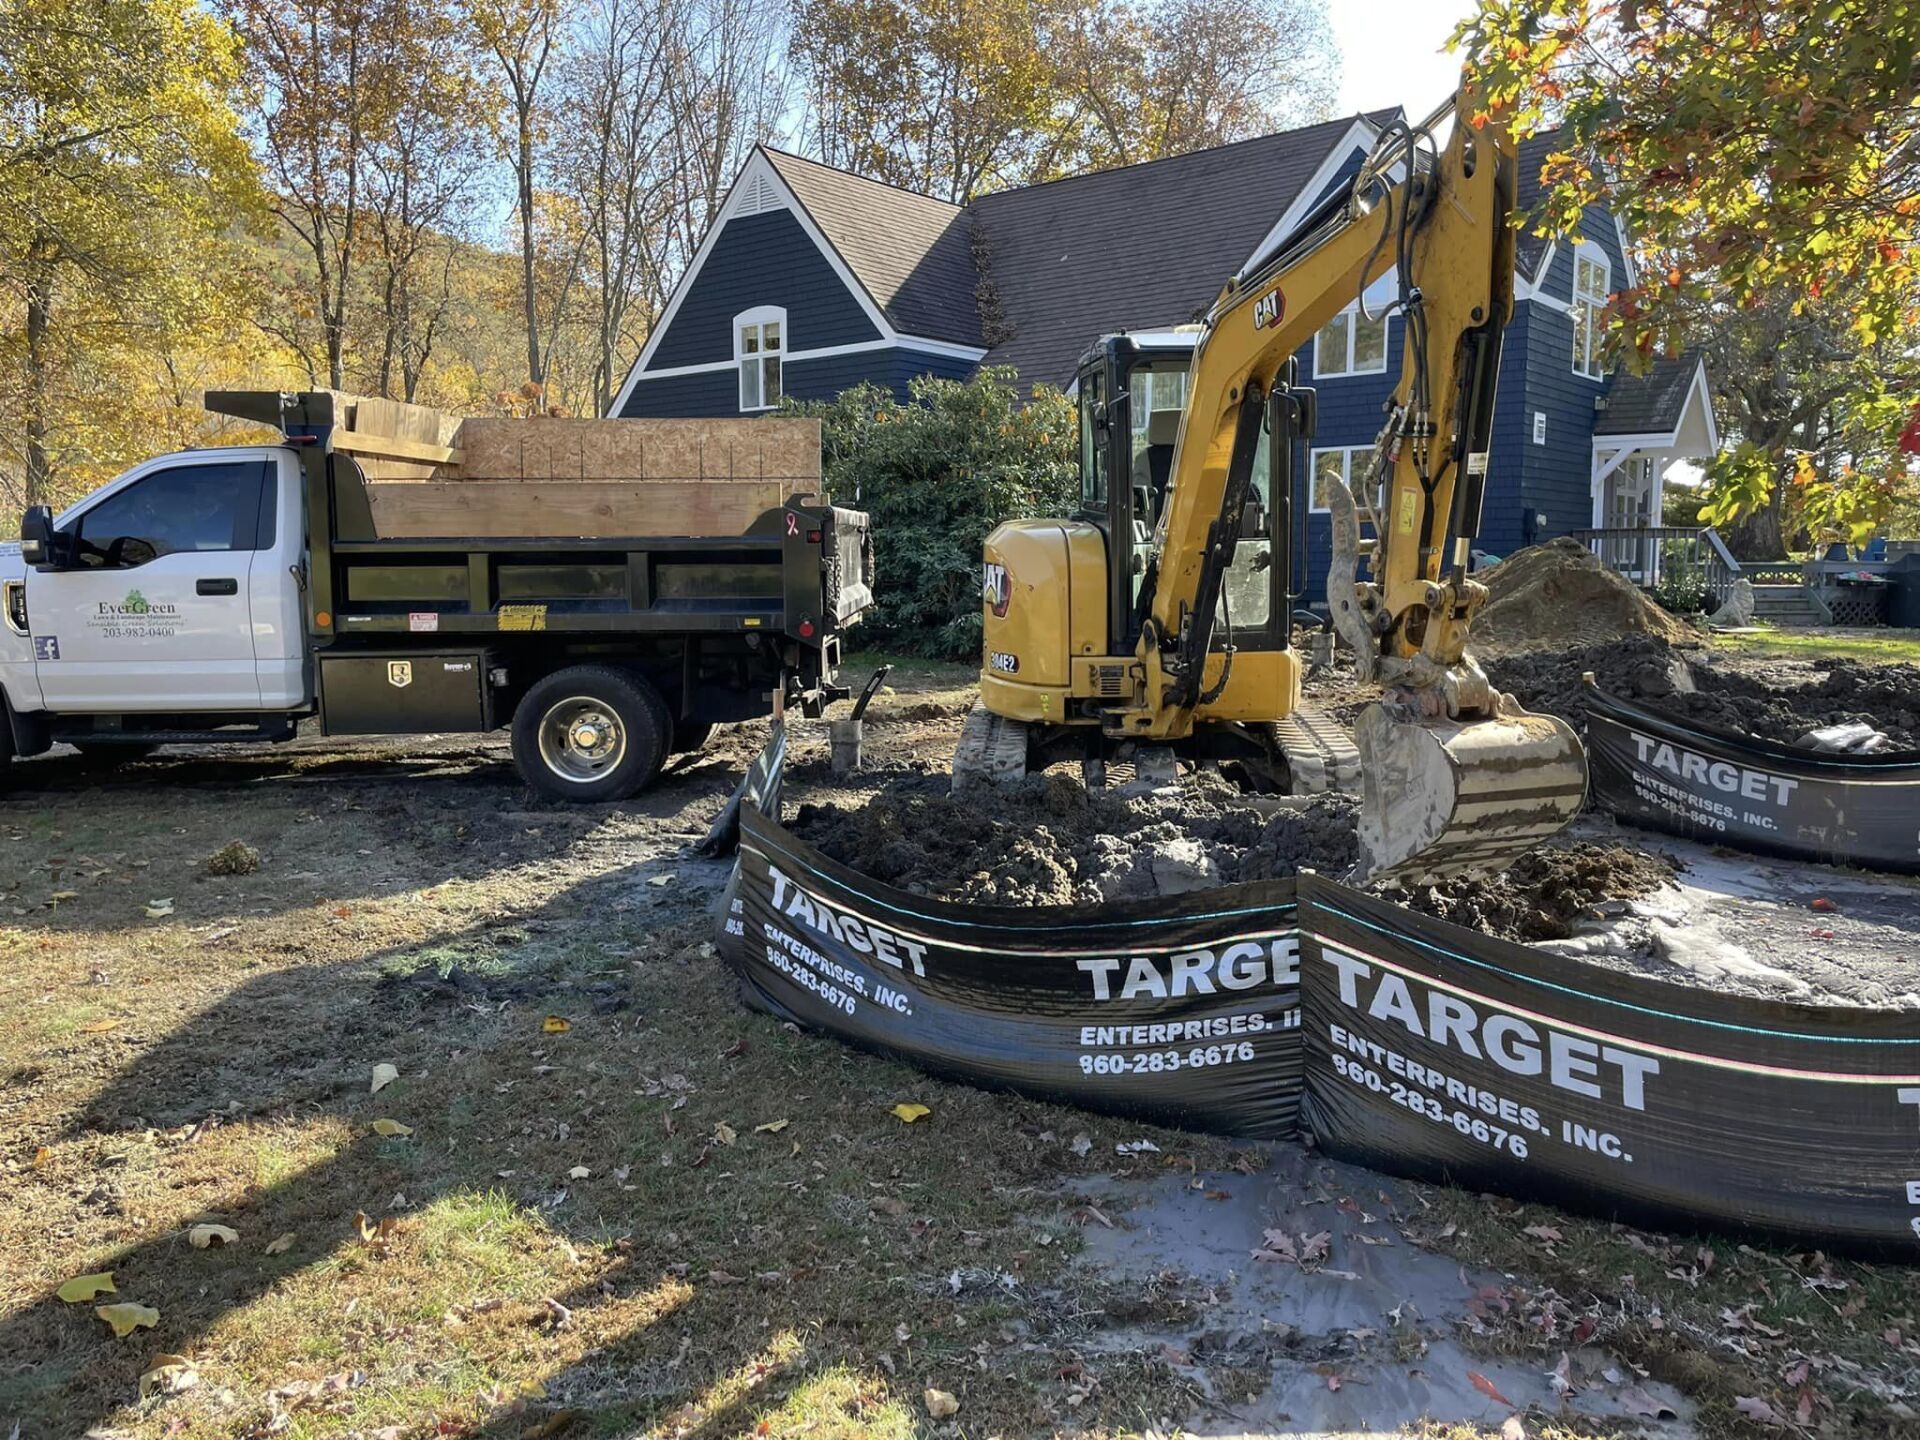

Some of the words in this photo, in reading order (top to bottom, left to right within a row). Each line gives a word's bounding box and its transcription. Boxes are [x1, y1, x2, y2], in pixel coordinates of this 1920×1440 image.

[1254, 290, 1277, 329] CAT
[983, 563, 1005, 604] AT
[99, 601, 176, 614] EverGreen
[103, 627, 175, 638] 203-982-0400
[1631, 732, 1798, 806] TARGET
[1744, 812, 1778, 830] INC.
[768, 865, 928, 977] TARGET
[874, 985, 912, 1016] INC.
[1081, 1013, 1273, 1045] ENTERPRISES.
[1321, 947, 1660, 1111] TARGET
[1080, 1042, 1255, 1074] 860-283-6676
[1330, 1024, 1551, 1136] ENTERPRISES.
[1562, 1121, 1633, 1162] INC.
[1332, 1053, 1529, 1160] 860-283-6676
